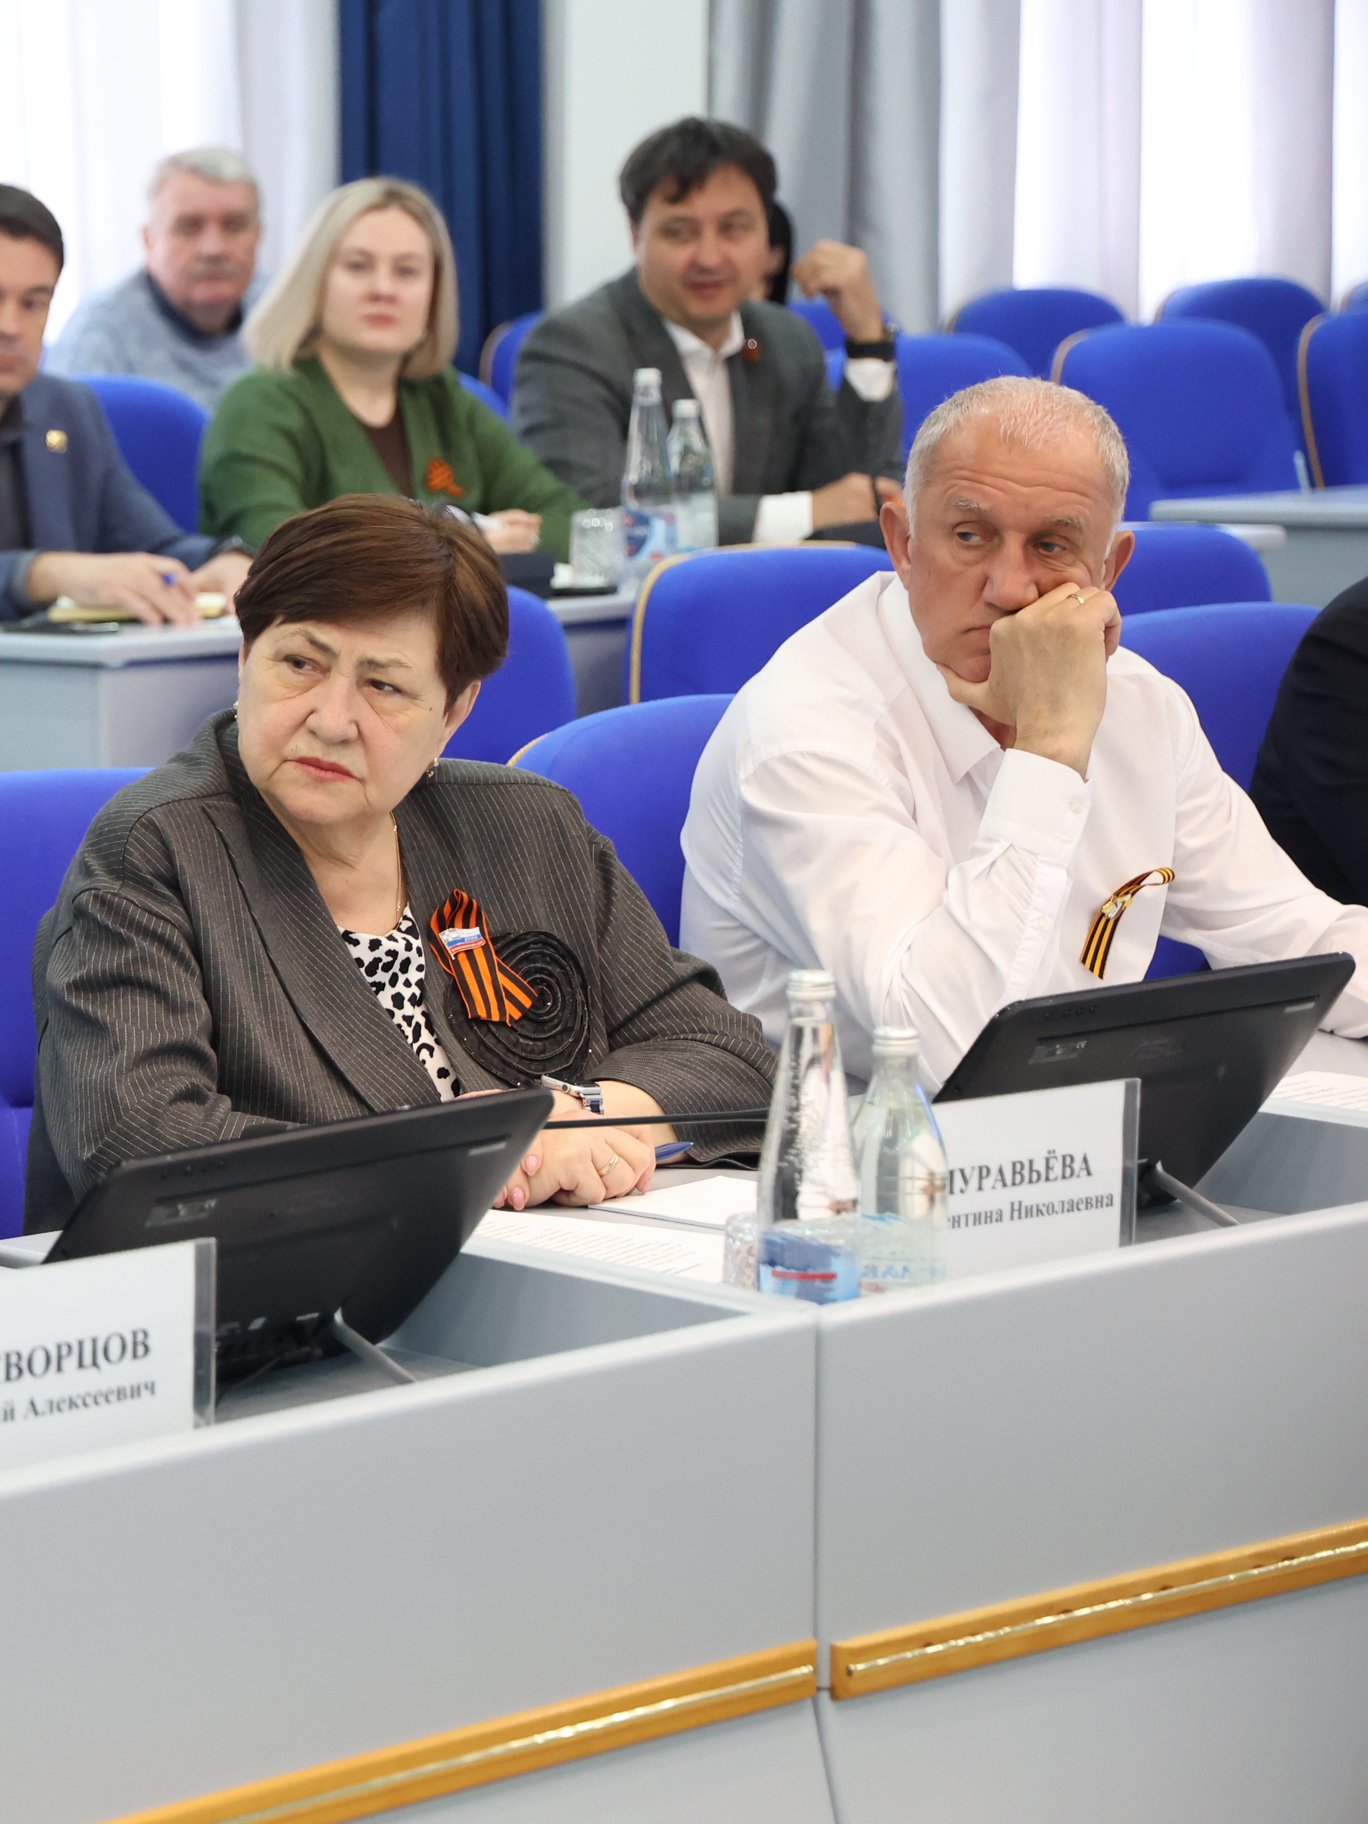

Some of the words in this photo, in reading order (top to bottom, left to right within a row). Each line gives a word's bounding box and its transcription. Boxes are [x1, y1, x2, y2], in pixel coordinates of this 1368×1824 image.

[947, 1207, 1003, 1229] нтина
[1009, 1193, 1114, 1221] Николаевна
[23, 1380, 155, 1420] Алексеевич
